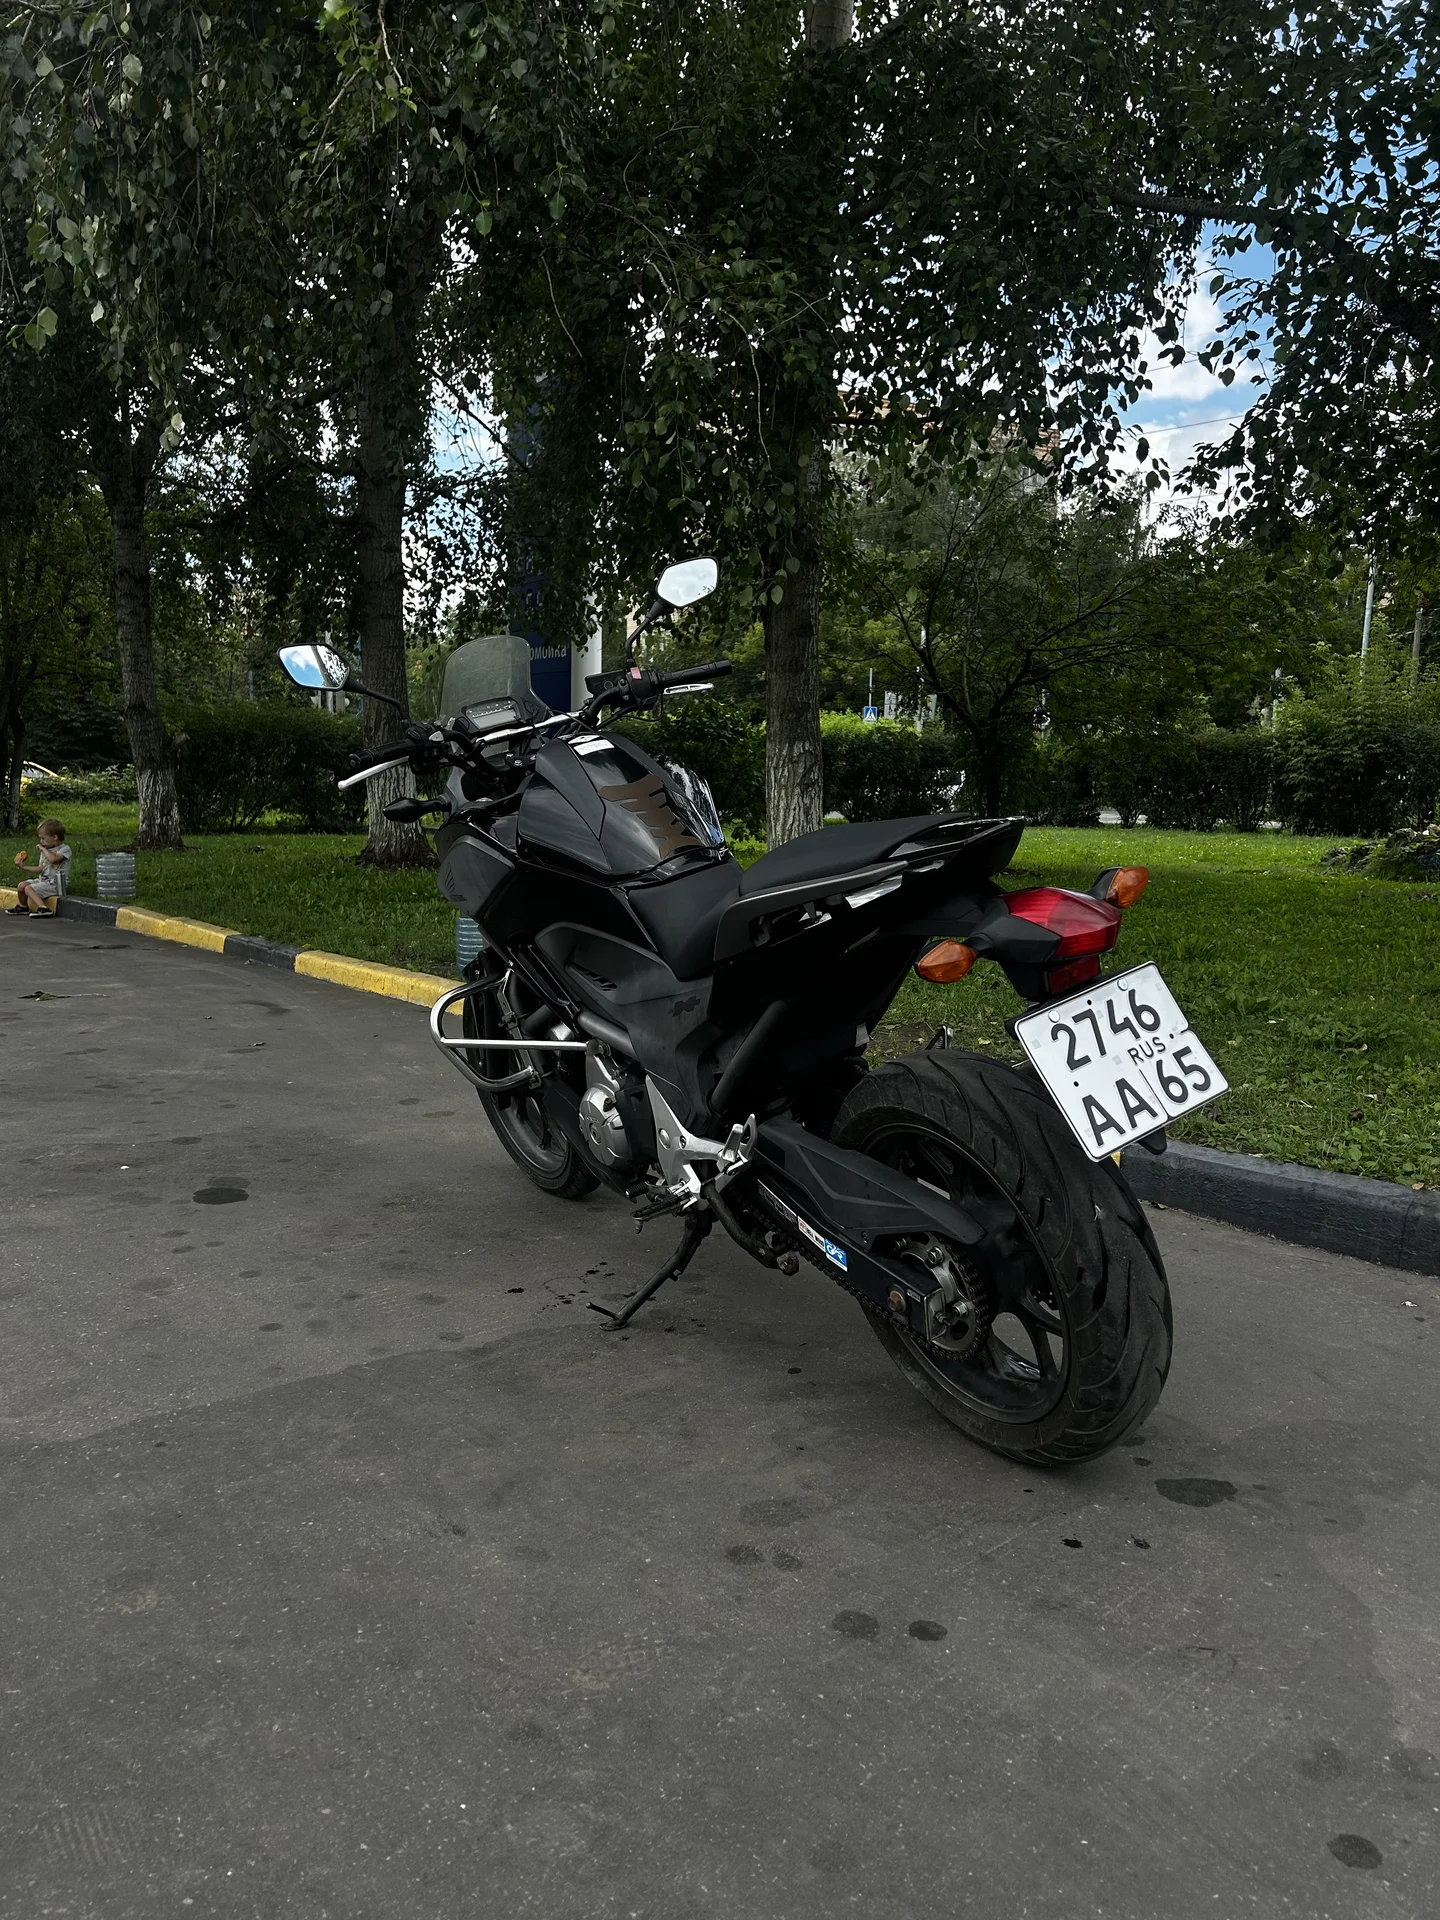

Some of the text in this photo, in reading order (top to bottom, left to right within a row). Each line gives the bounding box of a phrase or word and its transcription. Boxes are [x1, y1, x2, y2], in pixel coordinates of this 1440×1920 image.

[1050, 988, 1161, 1070] 2746
[1127, 1037, 1166, 1065] RUS
[1082, 1046, 1211, 1147] AA 65
